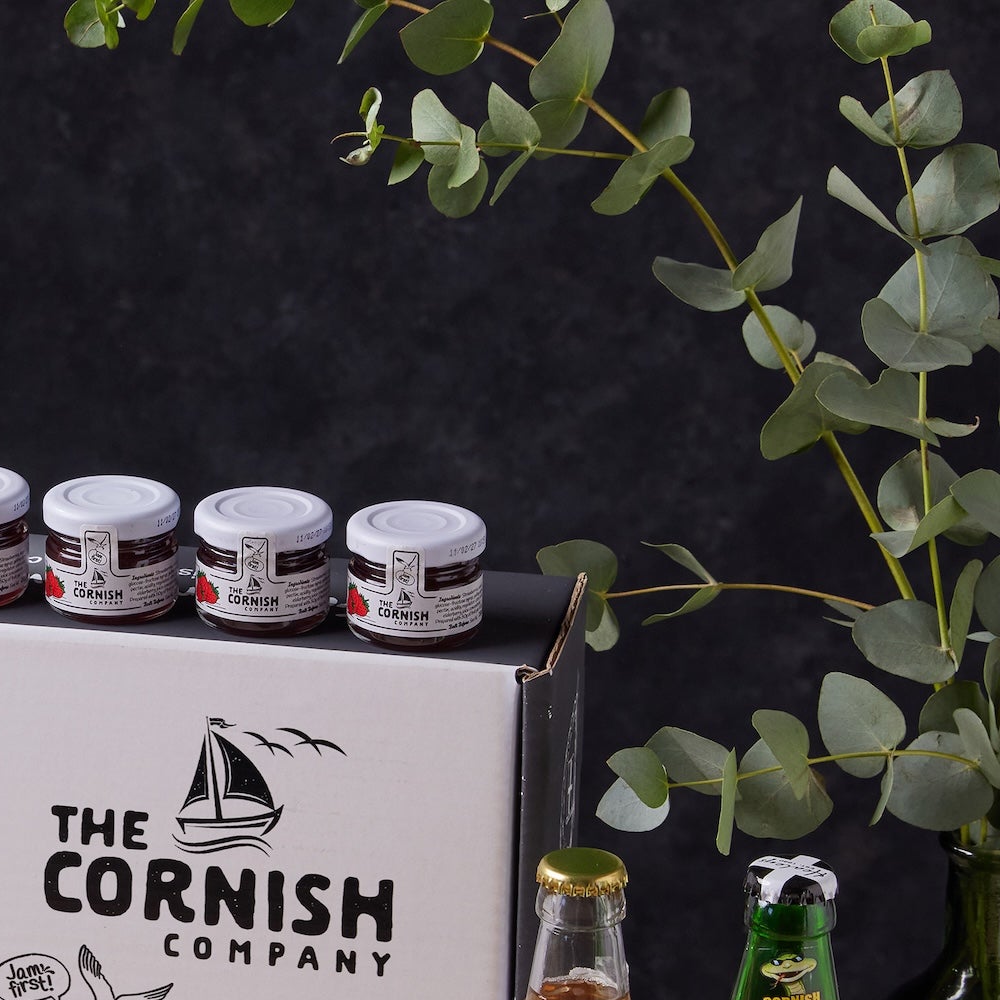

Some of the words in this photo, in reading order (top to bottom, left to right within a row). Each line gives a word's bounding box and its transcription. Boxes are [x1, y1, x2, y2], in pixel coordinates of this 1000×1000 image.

[74, 580, 87, 588] THE
[229, 586, 243, 594] THE
[73, 588, 123, 600] CORNISH
[228, 594, 279, 606] CORNISH
[379, 600, 393, 608] THE
[378, 607, 429, 621] CORNISH
[51, 804, 149, 851] THE
[44, 850, 394, 943] CORNISH
[164, 933, 391, 977] COMPANY
[8, 975, 54, 998] first!
